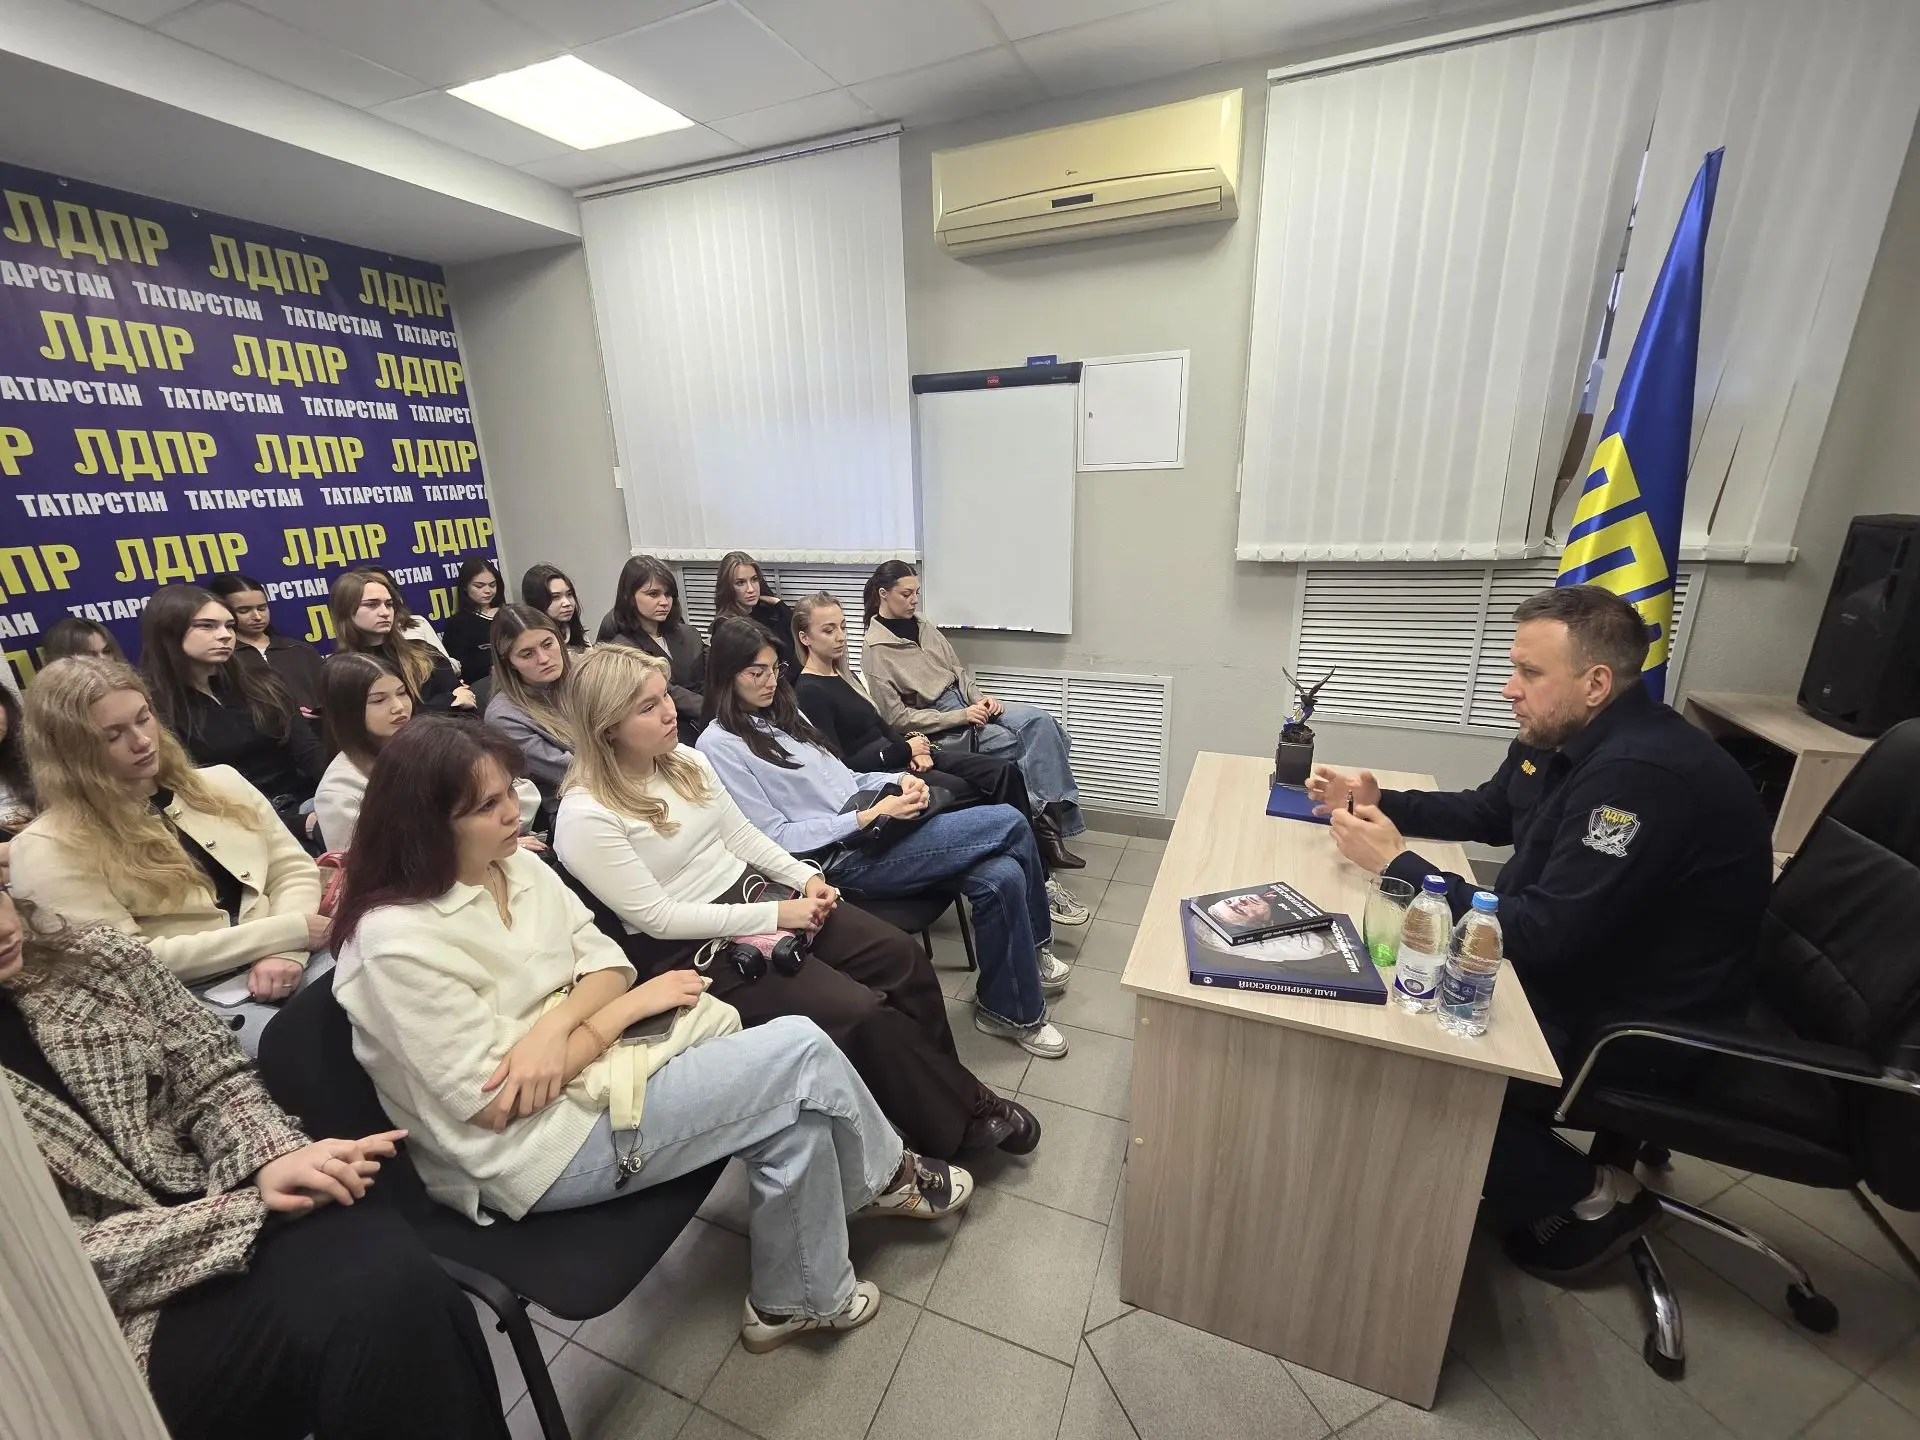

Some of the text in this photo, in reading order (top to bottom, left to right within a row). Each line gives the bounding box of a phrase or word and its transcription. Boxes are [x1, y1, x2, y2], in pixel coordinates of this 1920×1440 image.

[3, 189, 449, 318] ЛДПР ЛДПР ЛДПР
[0, 260, 458, 349] АРСТАН ТАТАРСТАН ТАТАРСТАН ТАТАРСТ
[40, 310, 464, 398] ЛДПР ЛДПР ЛДПР
[0, 375, 472, 424] АТАРСТАН ТАТАРСТАН ТАТАРСТАН ТАТАРСТ
[74, 428, 217, 481] ЛДПР
[254, 433, 364, 479] ЛДПР
[392, 439, 478, 478] ЛДПР
[17, 485, 488, 518] ТАТАРСТАН ТАТАРСТАН ТАТАРСТАН ТАТАРСТ
[0, 544, 80, 605] ПР
[115, 532, 248, 585] ЛДПР
[282, 524, 387, 570] ЛДПР
[412, 517, 494, 557] ЛДПР
[67, 578, 329, 622] ТАТАР РСТАН
[1238, 980, 1337, 997] НАШ ЖИРИНОВСКИЙ
